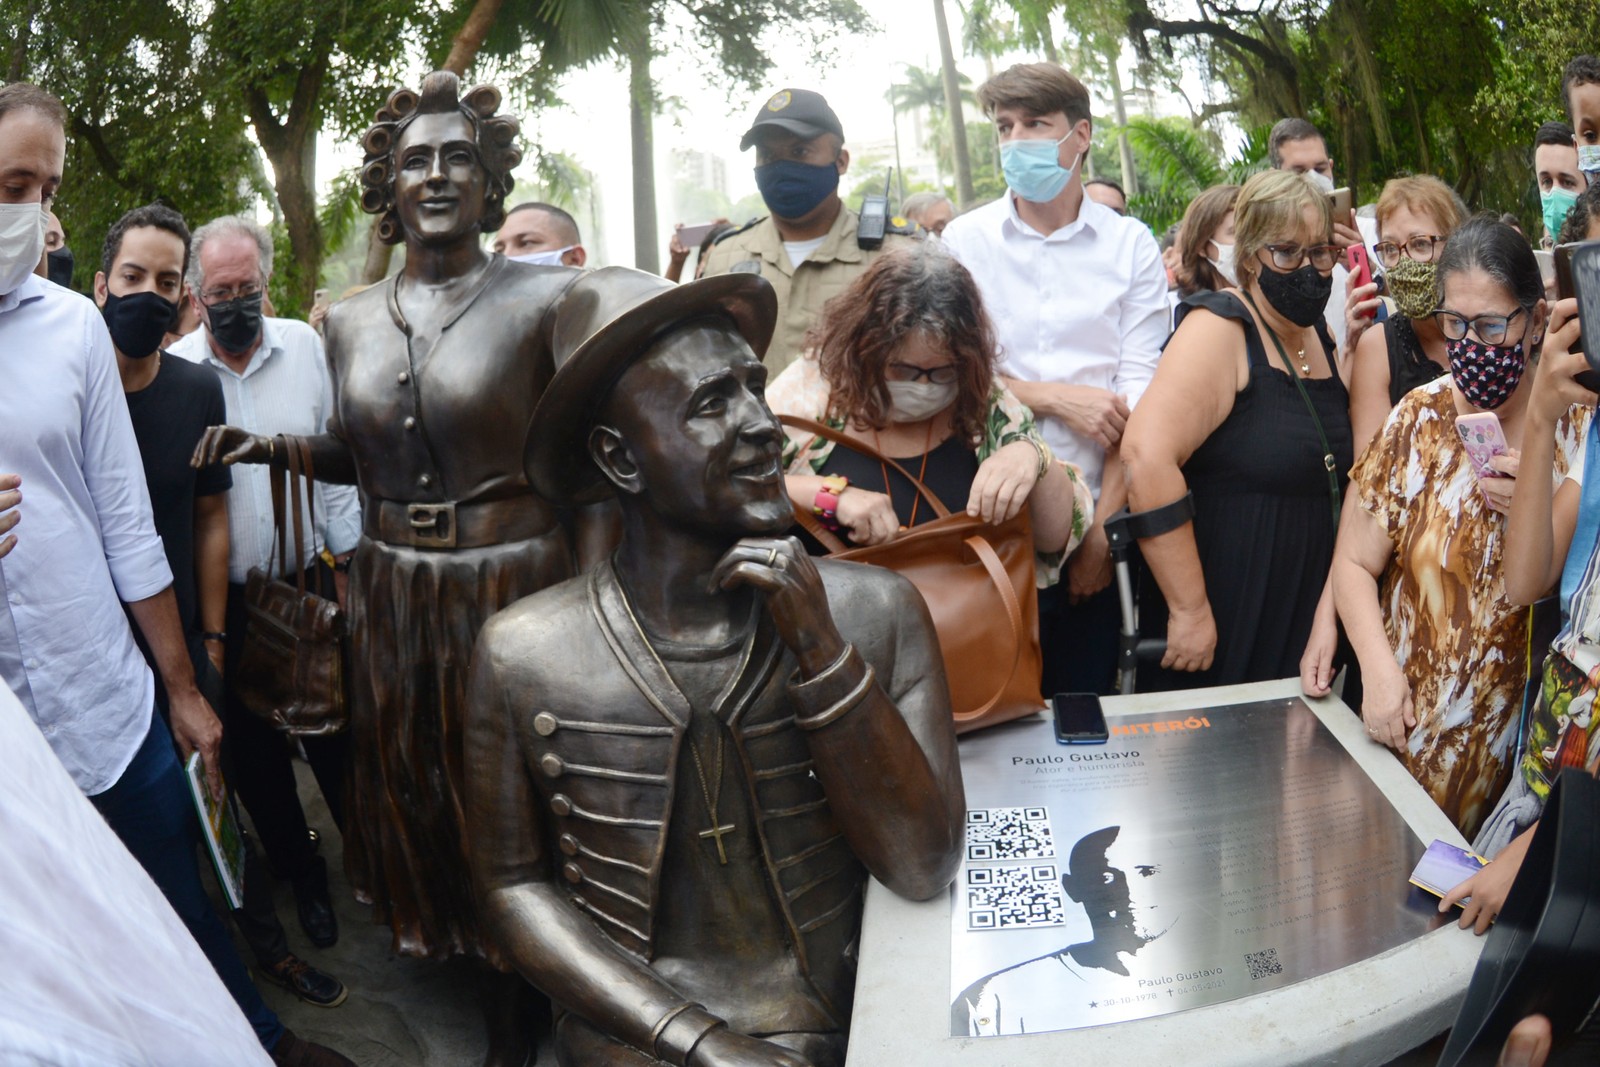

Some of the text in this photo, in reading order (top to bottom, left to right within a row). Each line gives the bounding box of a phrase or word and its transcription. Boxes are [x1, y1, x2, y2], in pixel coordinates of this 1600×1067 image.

[1012, 749, 1140, 766] Paulo Gustavo
[1035, 765, 1062, 775] Ator
[1079, 760, 1145, 772] humorista
[1138, 967, 1223, 988] Paulo Gustavo
[1103, 980, 1227, 1007] 30-10-1978 04-05-2021
